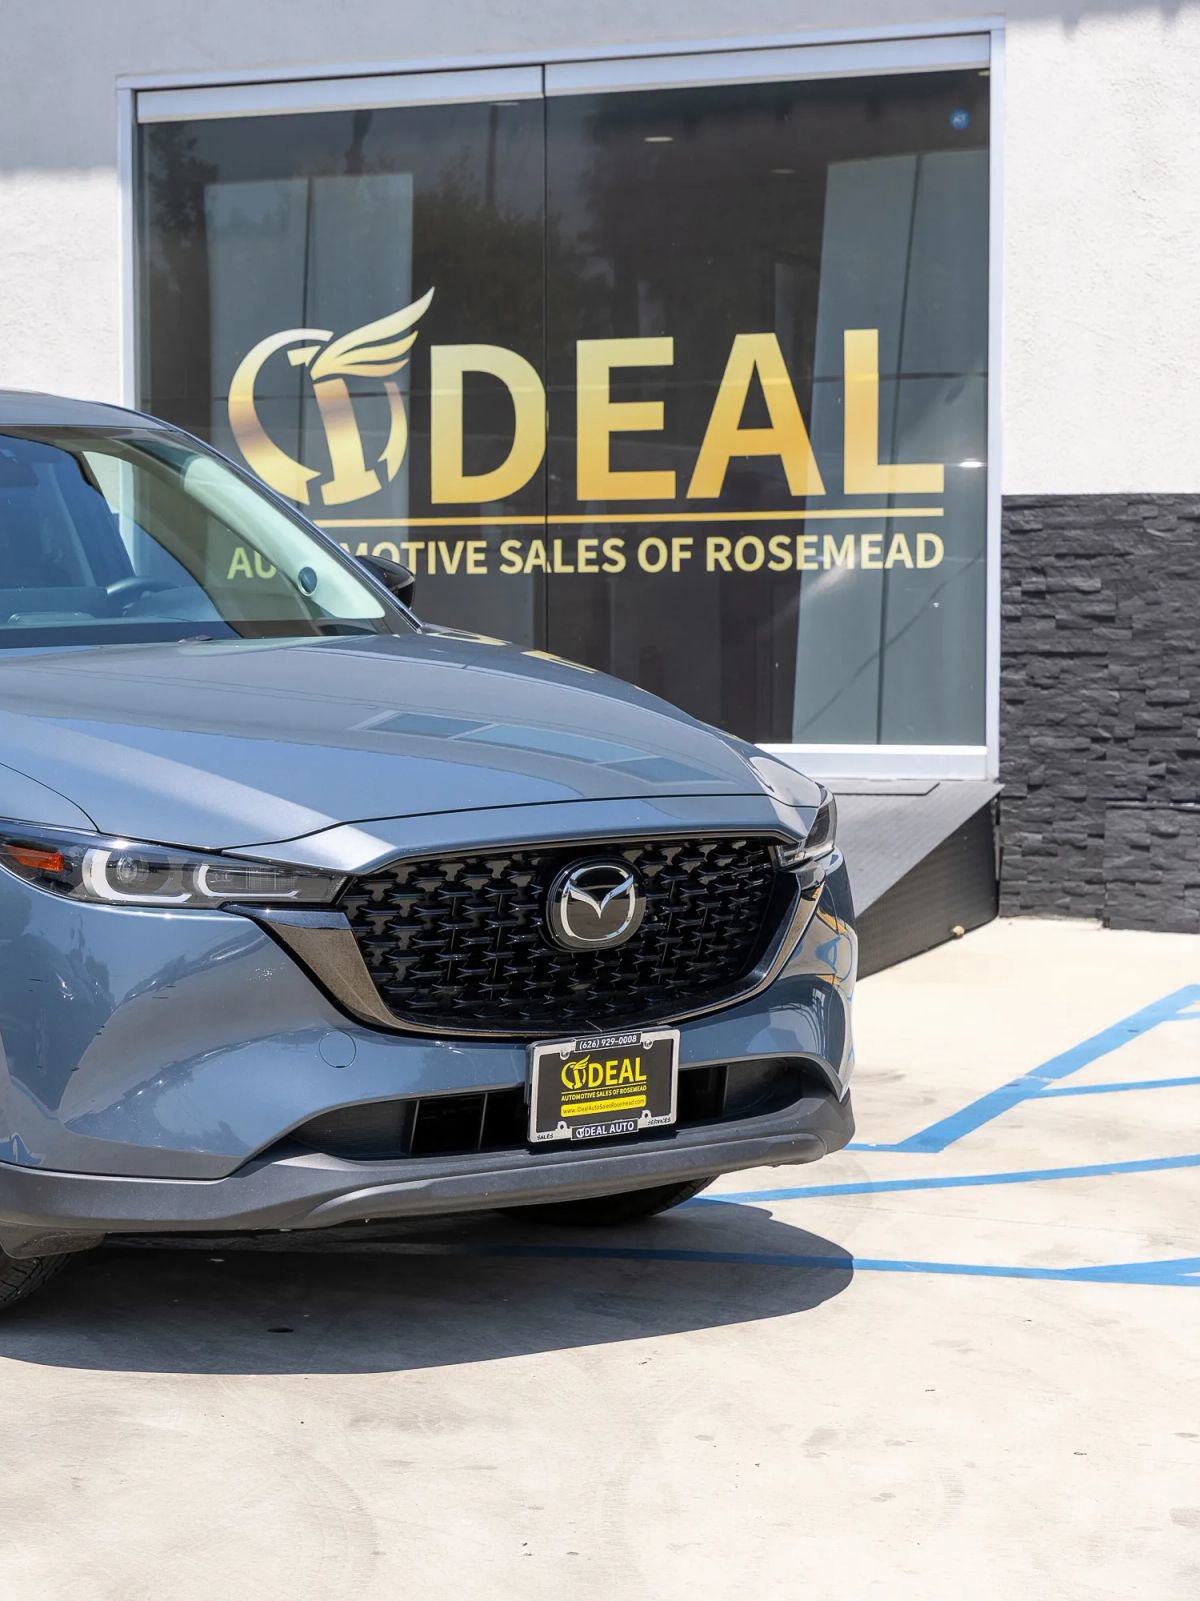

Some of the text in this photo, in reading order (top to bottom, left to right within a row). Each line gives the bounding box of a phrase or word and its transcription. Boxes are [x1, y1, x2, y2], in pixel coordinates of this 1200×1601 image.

[500, 538, 626, 574] SALES
[637, 536, 694, 574] OF
[706, 532, 945, 573] ROSEMEAD
[579, 1034, 637, 1050] (626) 929-0008
[561, 1085, 647, 1102] AUTOMOTIVE SALES OF ROSEMEAD
[609, 1121, 635, 1133] AUTO
